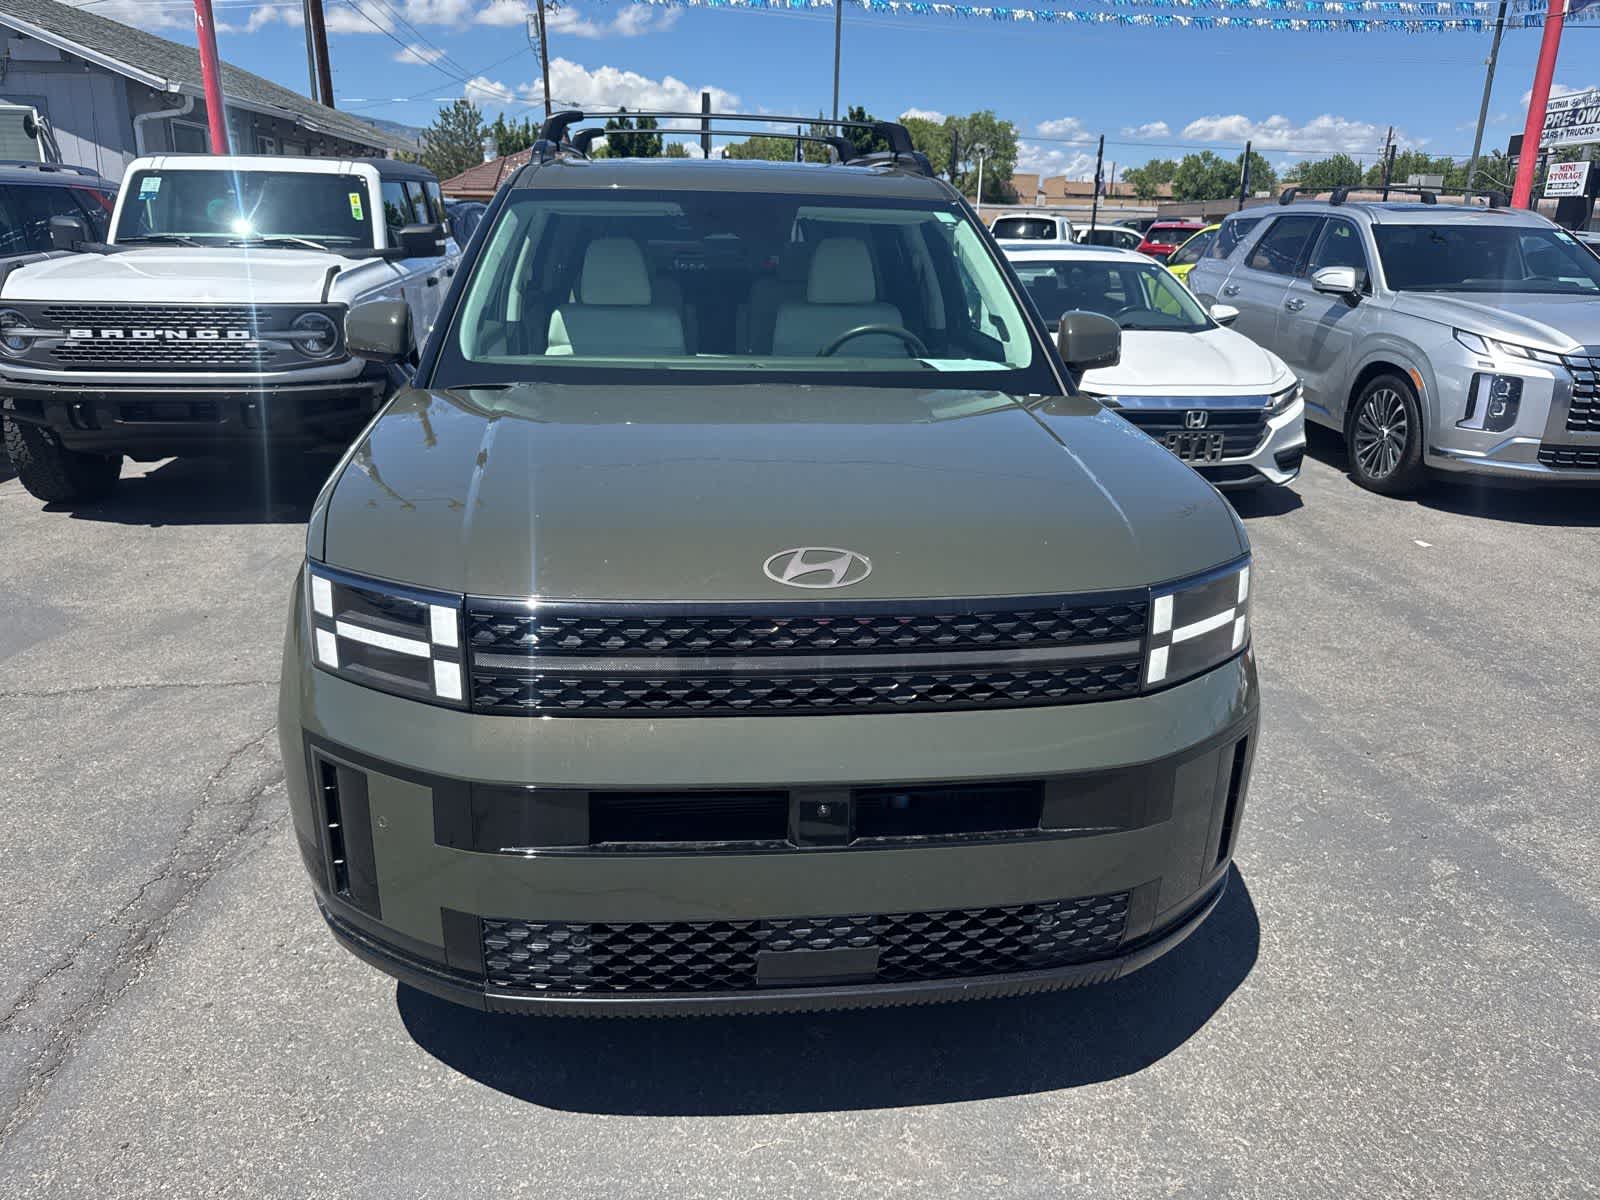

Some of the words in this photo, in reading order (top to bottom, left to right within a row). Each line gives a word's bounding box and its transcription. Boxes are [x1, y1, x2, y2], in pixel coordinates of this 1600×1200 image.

[1541, 129, 1559, 139] CARS
[1566, 127, 1594, 136] TRUCKS
[1559, 164, 1576, 172] MINI
[1549, 172, 1583, 181] STORAGE
[69, 329, 250, 339] BRONCO
